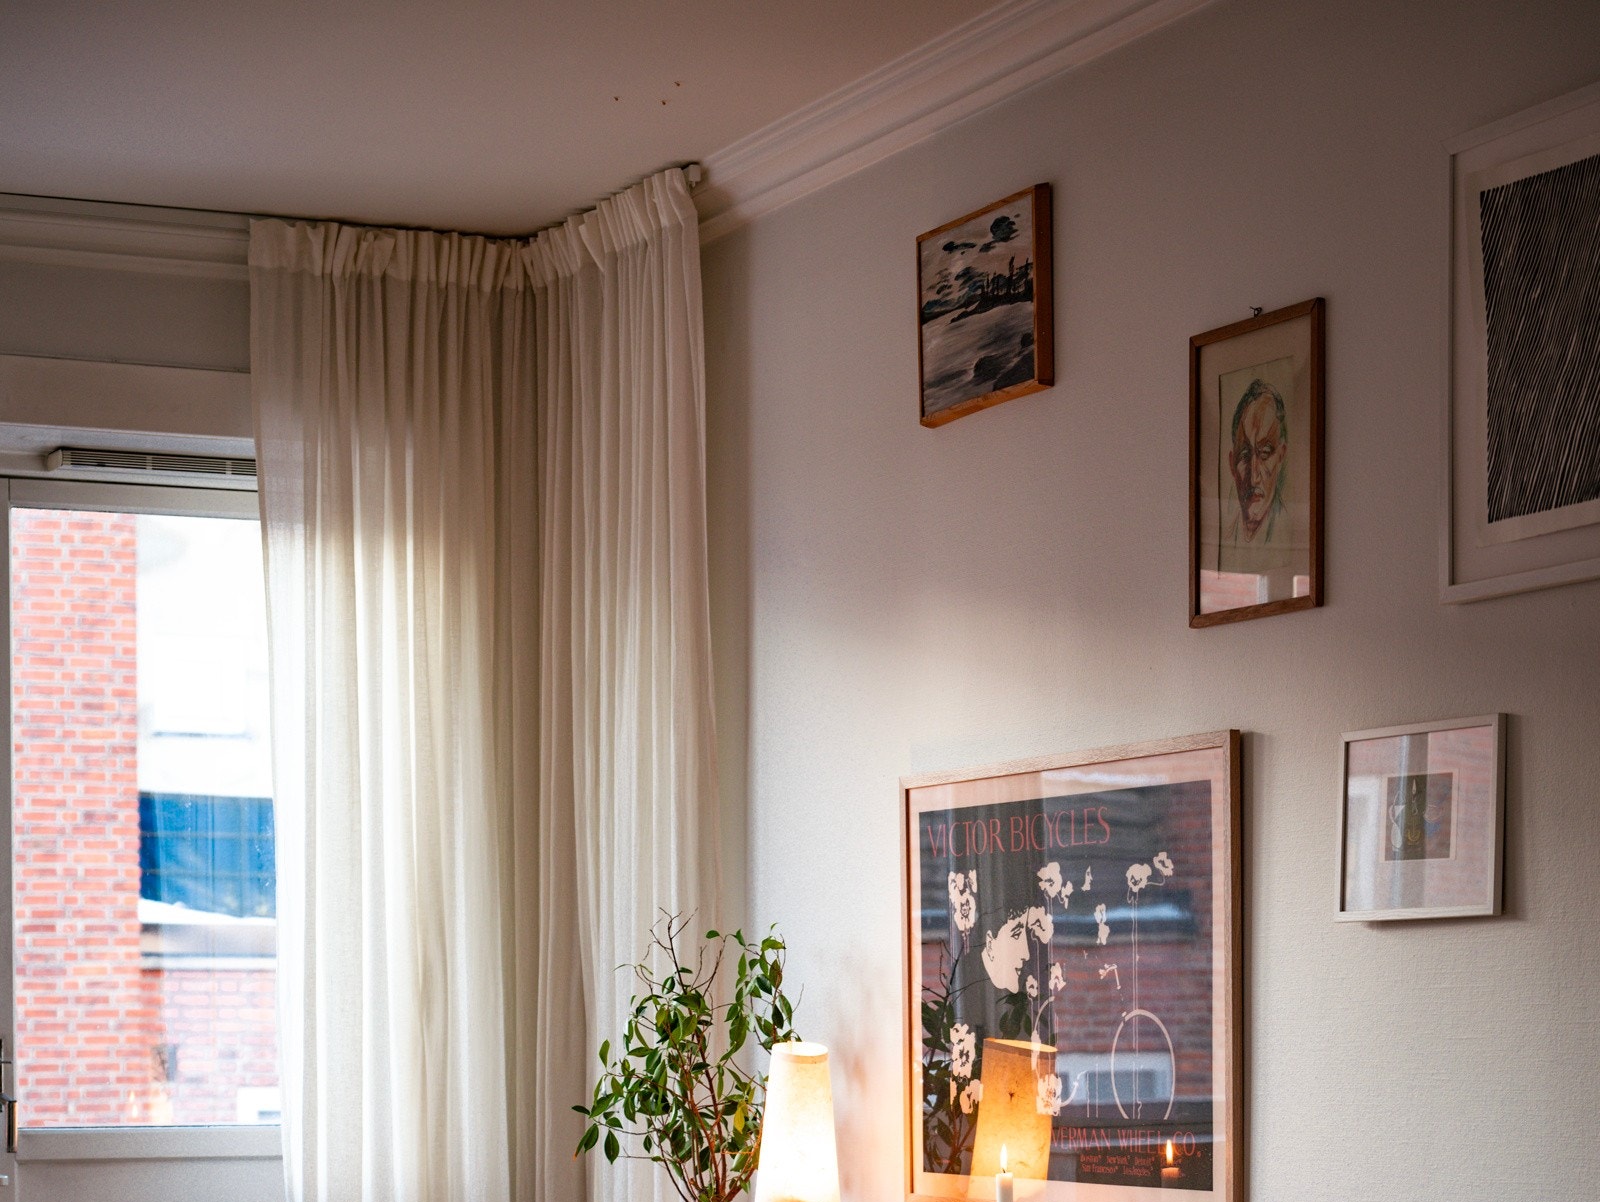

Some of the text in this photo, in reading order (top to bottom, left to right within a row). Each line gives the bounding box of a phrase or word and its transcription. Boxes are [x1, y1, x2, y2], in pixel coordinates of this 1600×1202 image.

[927, 806, 1111, 858] VICTOR BICYCLES
[1051, 1126, 1202, 1158] VERMAN WHEEL CO.
